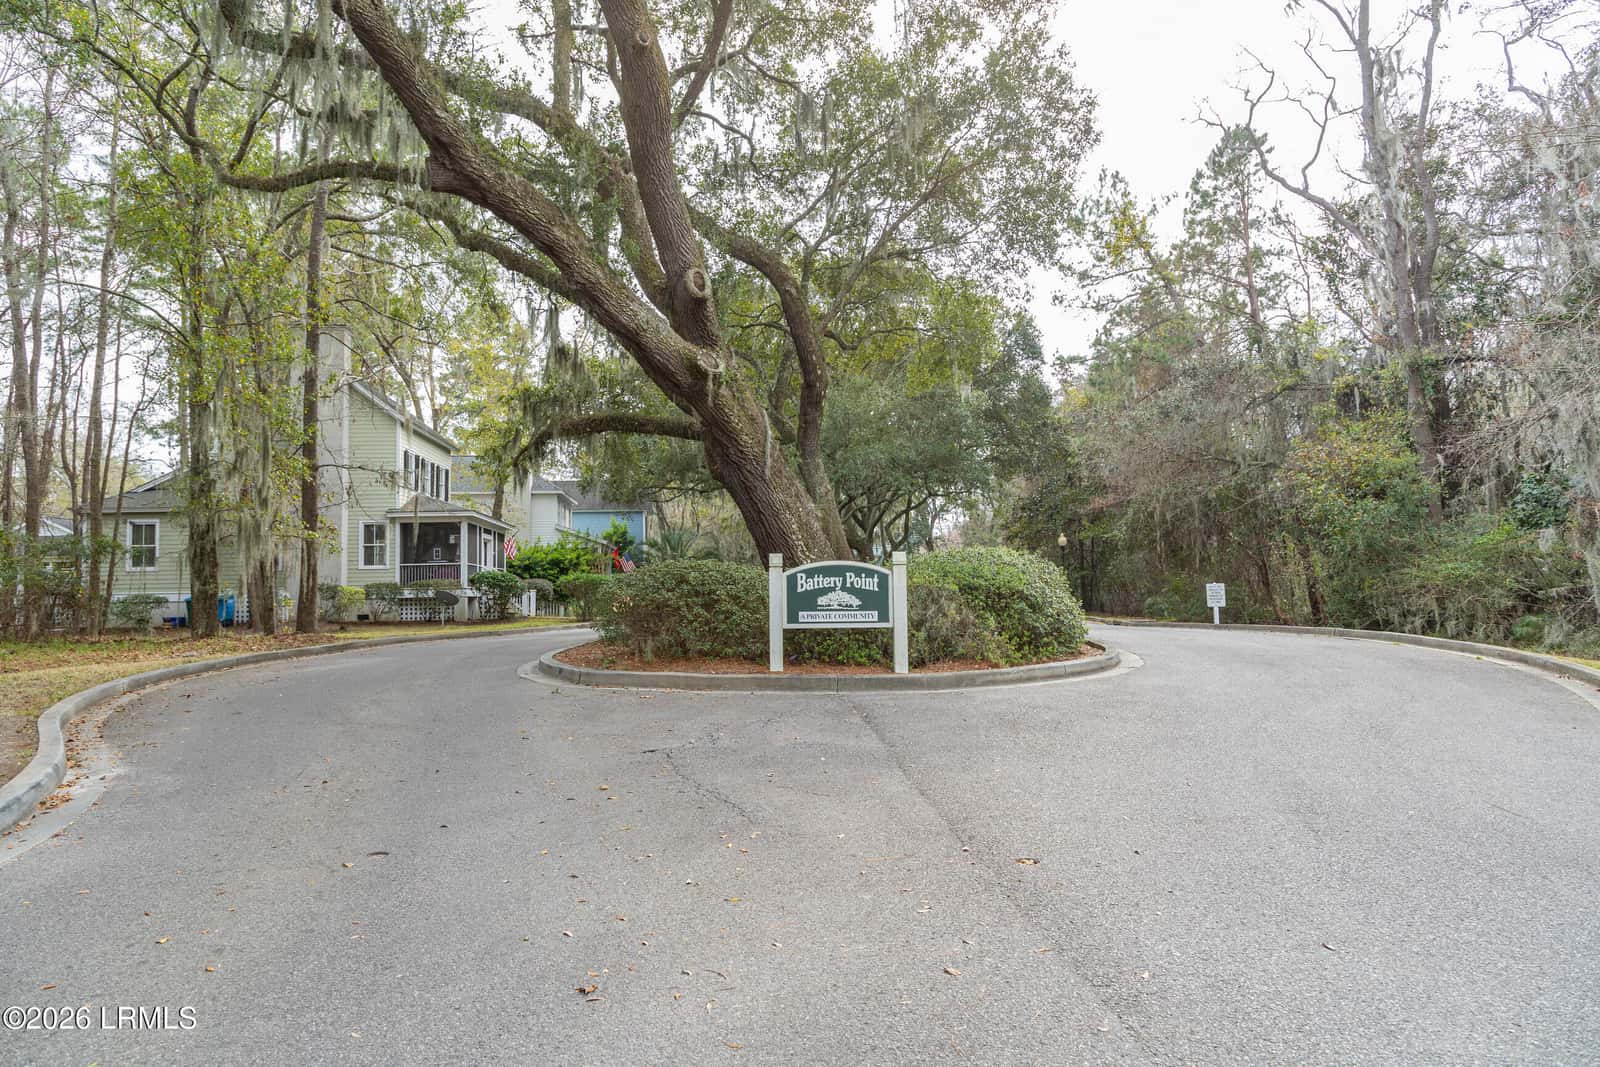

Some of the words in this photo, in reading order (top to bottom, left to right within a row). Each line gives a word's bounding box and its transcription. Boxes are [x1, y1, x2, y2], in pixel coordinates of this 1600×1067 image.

[796, 572, 843, 592] Battery
[846, 572, 879, 591] Point
[833, 612, 875, 620] COMMUNITY
